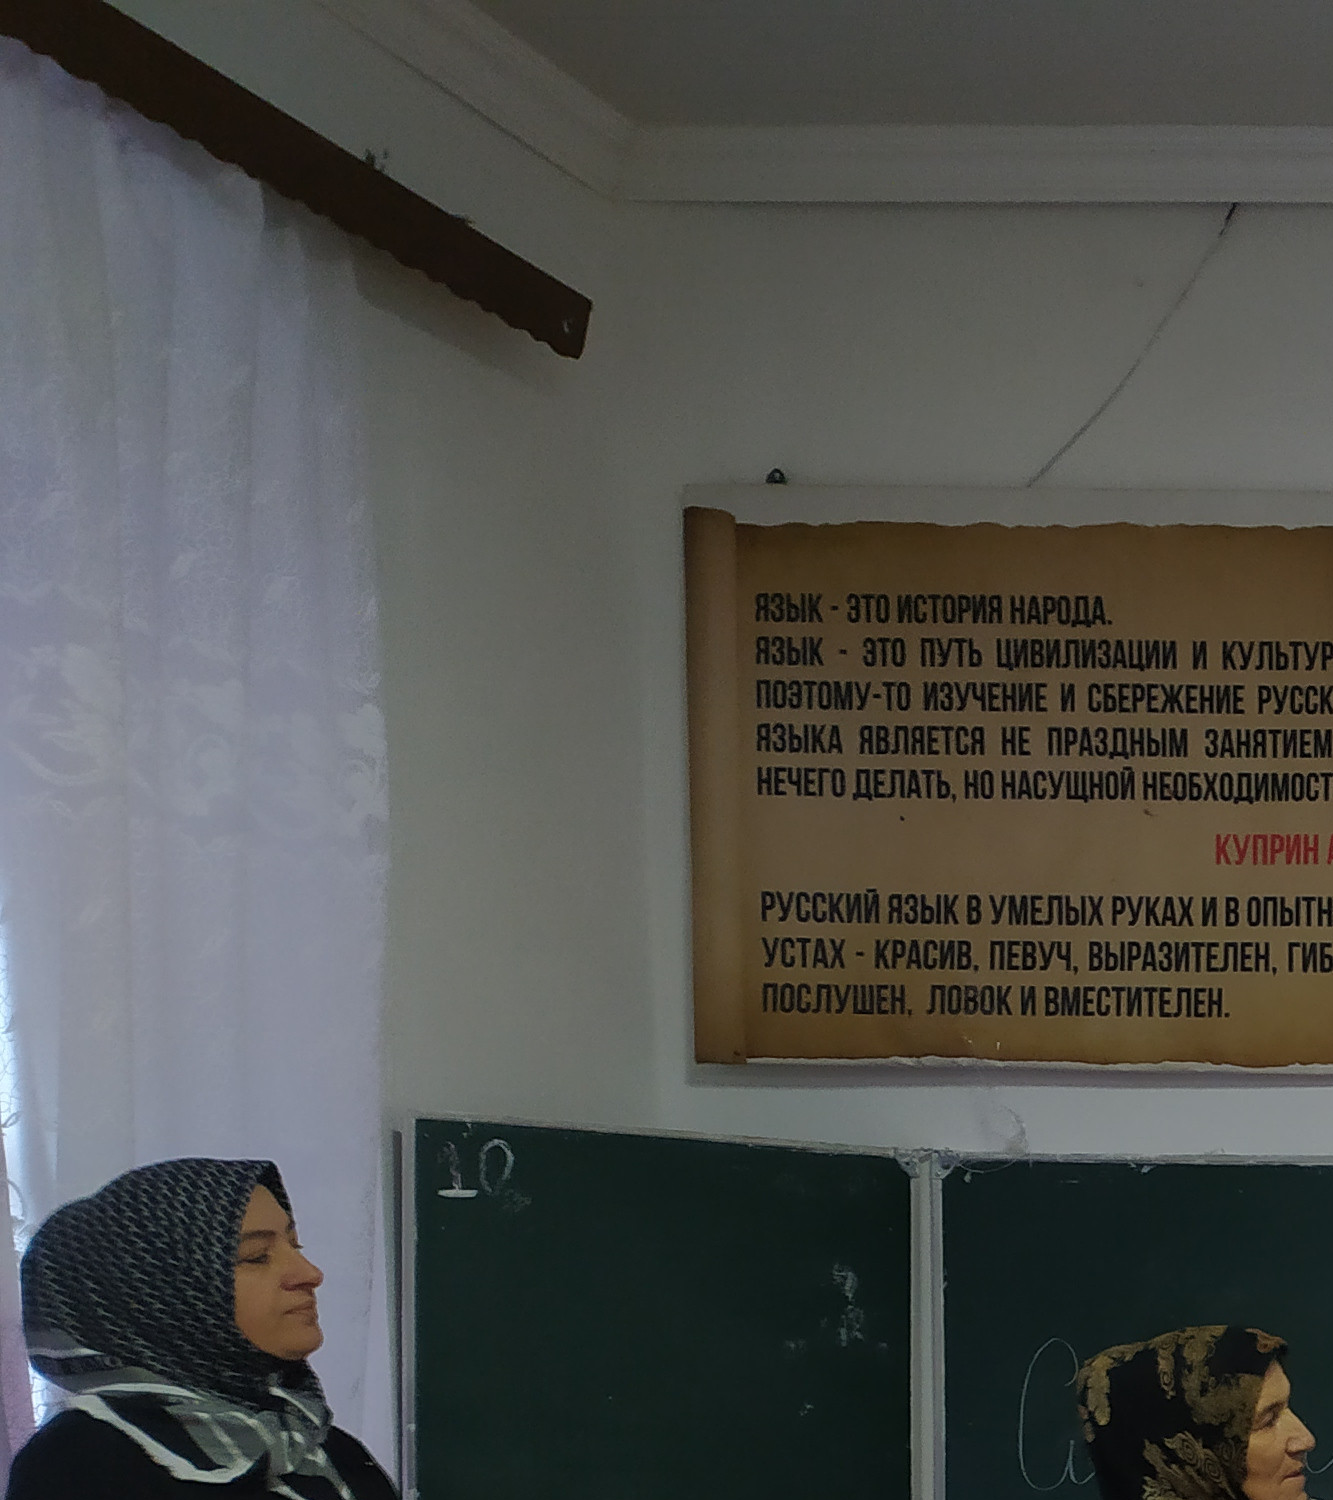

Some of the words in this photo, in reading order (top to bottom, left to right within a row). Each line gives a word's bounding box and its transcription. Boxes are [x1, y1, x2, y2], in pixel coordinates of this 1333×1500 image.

[755, 593, 823, 623] ЯЗЫК
[847, 593, 890, 624] ЭТО
[897, 594, 1002, 624] ИСТОРИЯ
[1010, 595, 1112, 628] НАРОДА.
[756, 636, 824, 666] ЯЗЫК
[863, 637, 906, 667] ЭТО
[921, 638, 982, 667] ПУТЬ
[996, 638, 1177, 672] ЦИВИЛИЗАЦИИ
[1193, 641, 1207, 670] И
[756, 680, 911, 711] ПОЭТОМУ-ТО
[923, 682, 1047, 712] ИЗУЧЕНИЕ
[1061, 683, 1075, 712] И
[1088, 683, 1245, 714] СБЕРЕЖЕНИЕ
[757, 723, 843, 754] ЯЗЫКА
[859, 725, 985, 755] ЯВЛЯЕТСЯ
[1002, 726, 1031, 756] НЕ
[1048, 727, 1188, 760] ПРАЗДНЫМ
[1205, 729, 1332, 758] ЗАНЯТИЕМ
[757, 767, 846, 798] НЕЧЕГО
[853, 769, 956, 802] ДЕЛАТЬ,
[964, 770, 994, 799] НО
[1001, 766, 1135, 803] НАСУЩНОЙ
[1216, 834, 1319, 865] КУПРИН
[761, 889, 879, 923] РУССКИЙ
[888, 894, 959, 925] ЯЗЫК
[967, 895, 982, 925] В
[989, 895, 1103, 926] УМЕЛЫХ
[1112, 896, 1194, 926] РУКАХ
[1202, 897, 1217, 927] И
[1225, 897, 1239, 927] В
[762, 937, 845, 969] УСТАХ
[990, 941, 1078, 975] ПЕВУЧ,
[1089, 941, 1277, 975] ВЫРАЗИТЕЛЕН,
[926, 985, 1012, 1015] ЛОВОК
[1021, 986, 1036, 1016] И
[1045, 986, 1229, 1018] ВМЕСТИТЕЛЕН.
